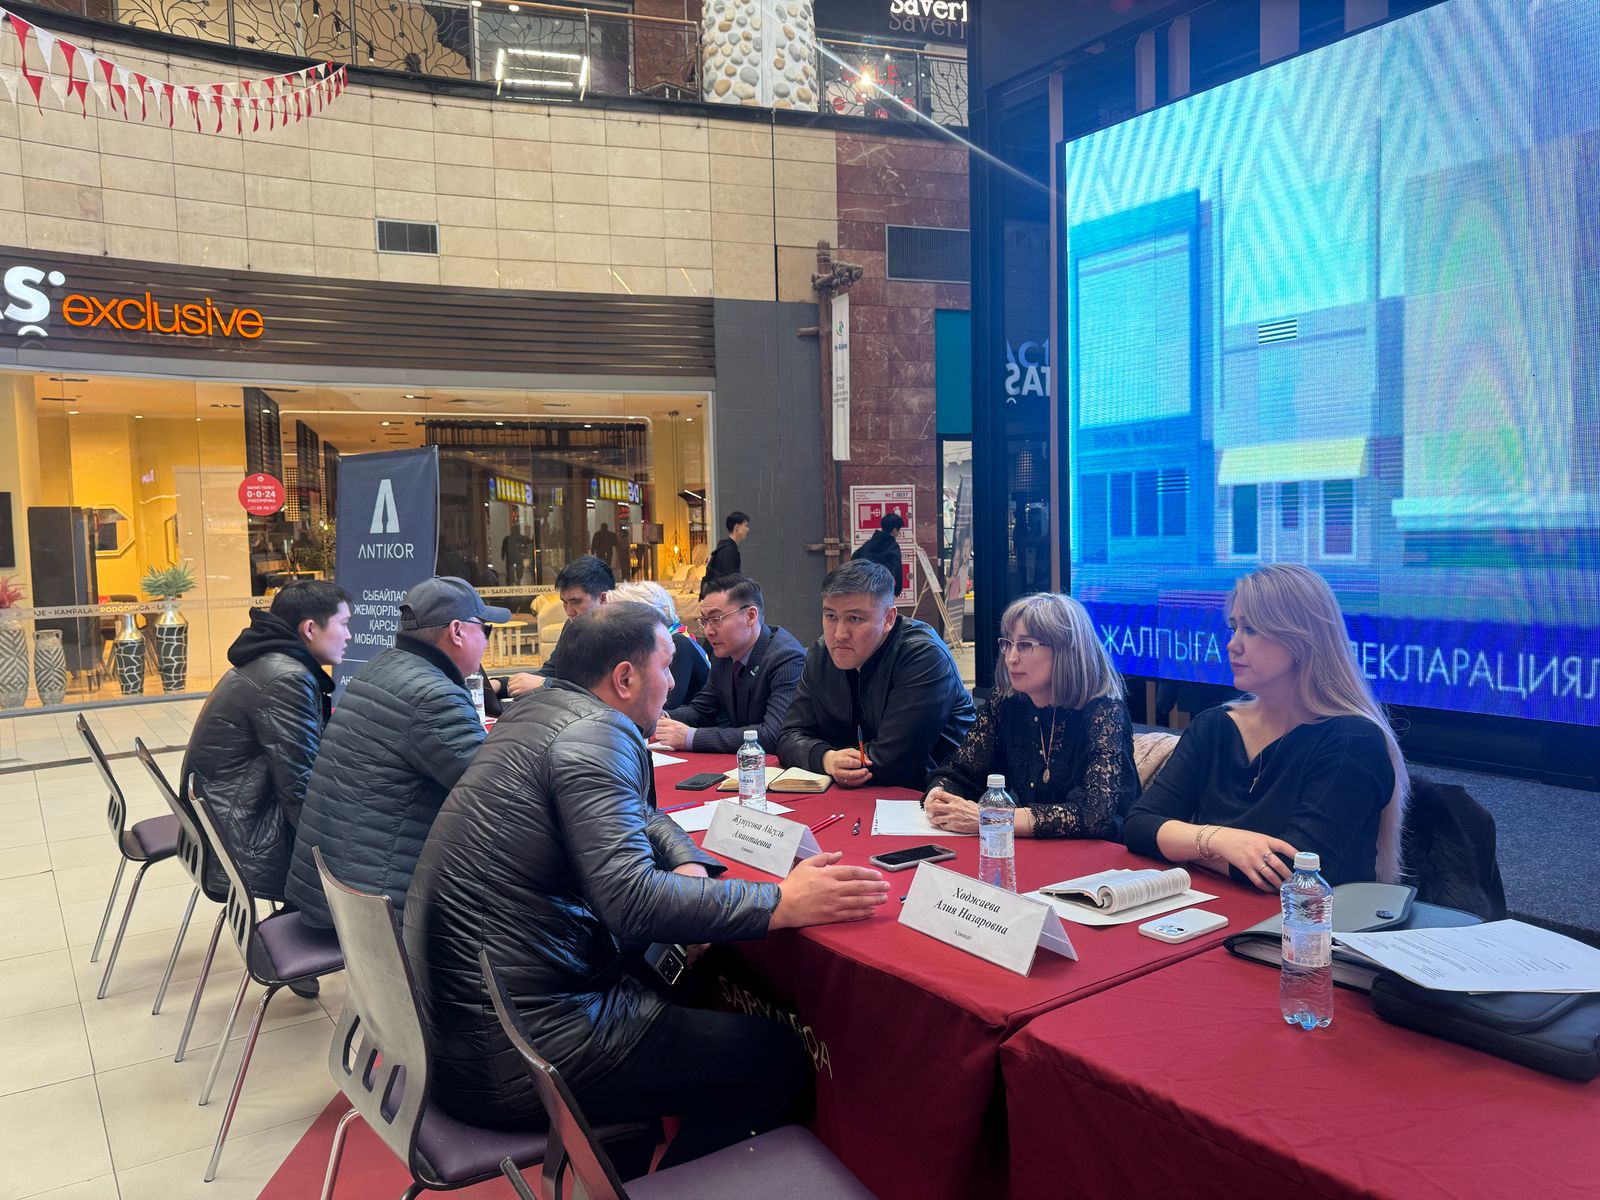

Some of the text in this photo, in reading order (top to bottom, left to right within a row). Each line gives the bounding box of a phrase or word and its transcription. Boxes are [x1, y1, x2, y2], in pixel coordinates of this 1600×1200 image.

[62, 291, 265, 339] exclusive
[362, 588, 408, 602] СЫБАЙЛАС
[490, 587, 523, 595] SARAJEVO
[54, 607, 94, 616] KAMPALA
[353, 603, 403, 618] ЖЕМҚОРЛЫ
[369, 619, 399, 633] ҚАРСЫ
[1100, 624, 1222, 664] ЖАЛПЫҒА
[952, 887, 1001, 913] Ходжаева
[933, 899, 1009, 935] Алия Назаровна
